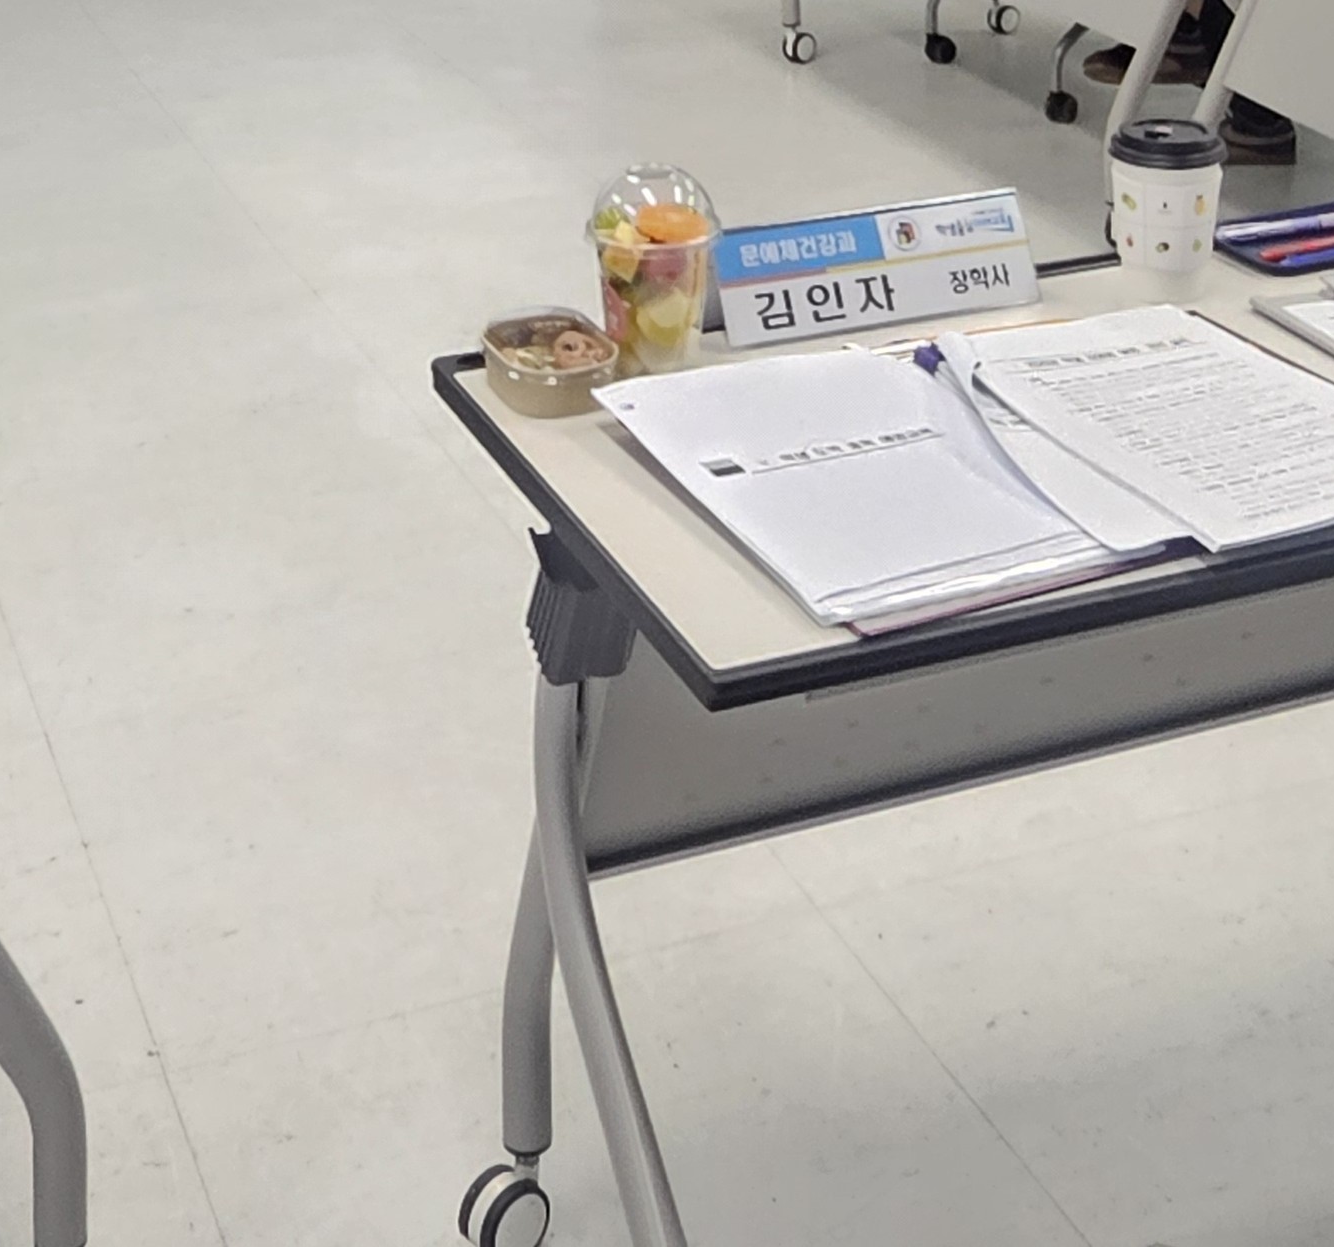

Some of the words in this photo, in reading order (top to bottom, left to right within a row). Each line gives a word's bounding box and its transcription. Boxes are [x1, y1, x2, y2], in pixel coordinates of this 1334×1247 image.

[739, 230, 858, 268] 문예체건강과
[754, 274, 896, 331] 김인자
[948, 263, 1011, 294] 장학사
